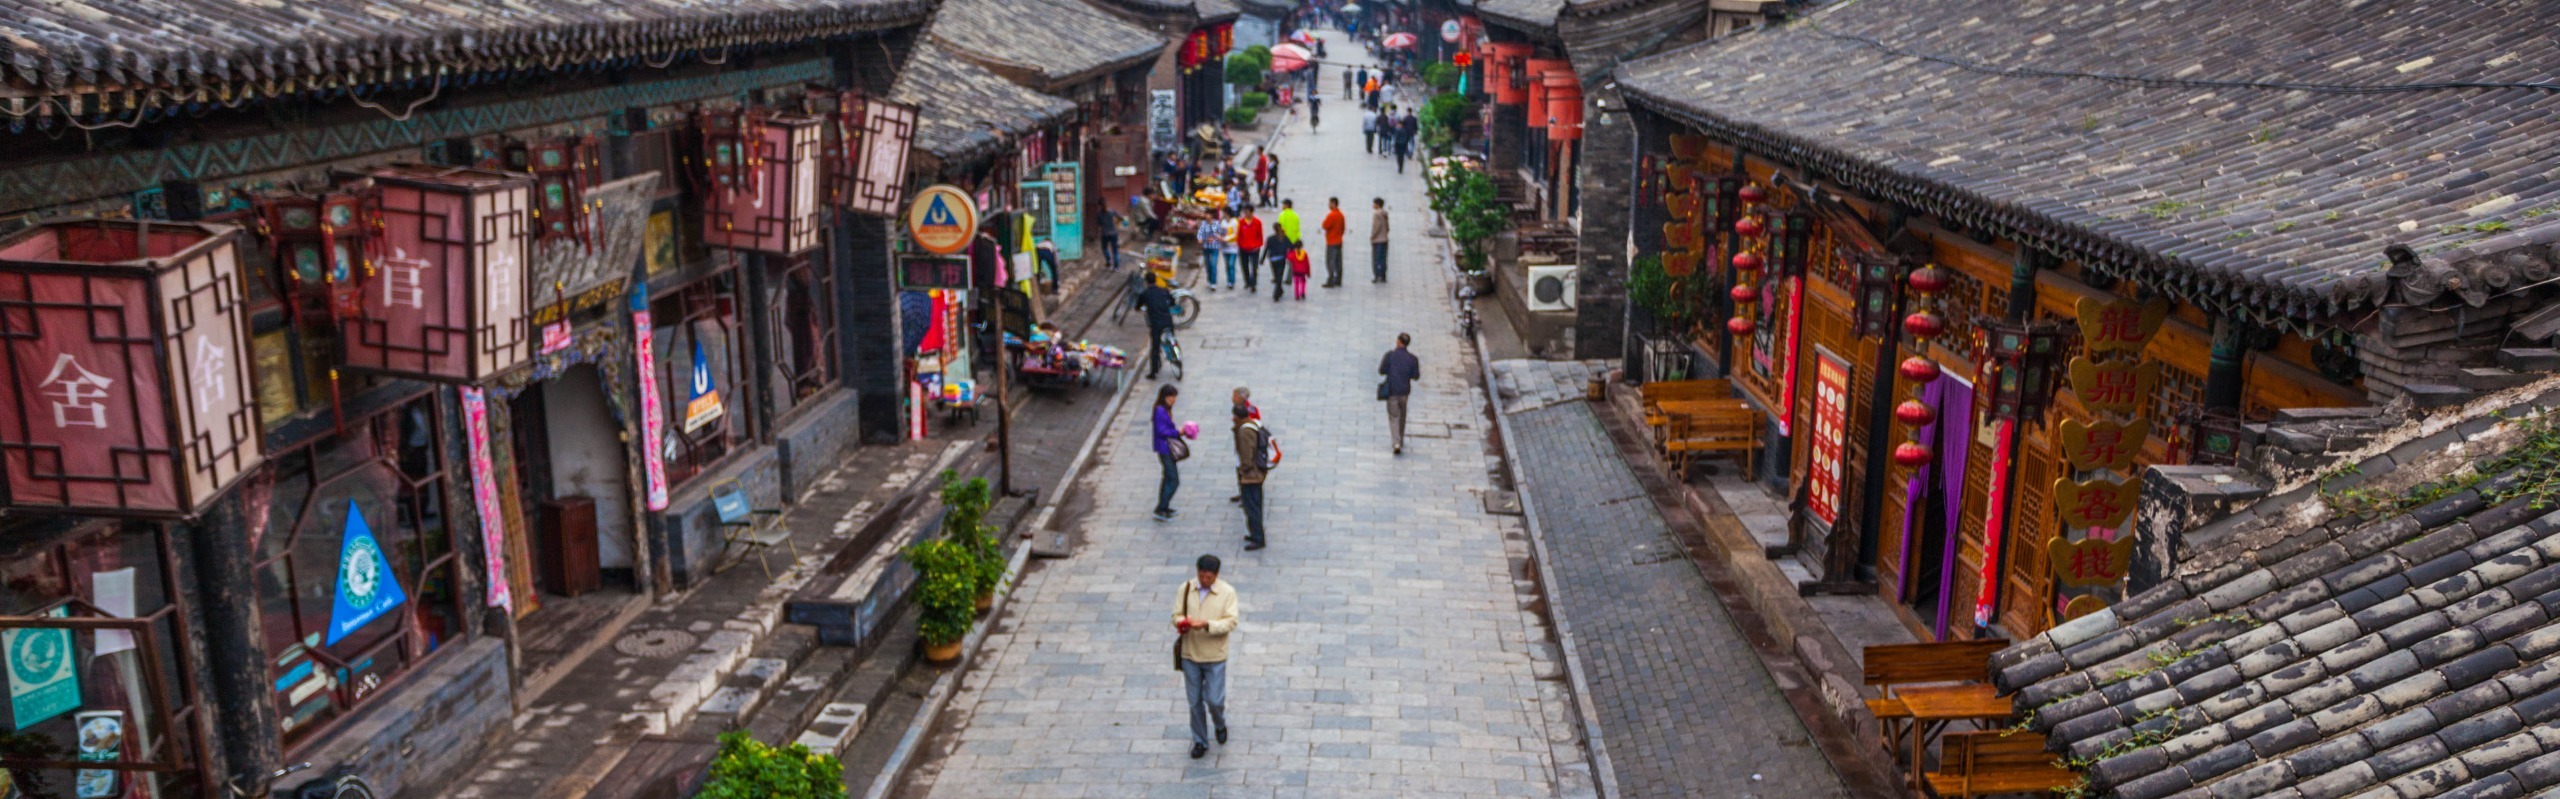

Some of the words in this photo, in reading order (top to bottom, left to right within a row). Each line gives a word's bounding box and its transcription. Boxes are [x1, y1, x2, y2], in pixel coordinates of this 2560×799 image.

[374, 247, 432, 310] 官
[487, 251, 514, 312] 官
[38, 352, 114, 429] 舍
[192, 334, 225, 414] 舍
[694, 363, 708, 394] U
[2069, 307, 2146, 580] 龍鼎昇客棧
